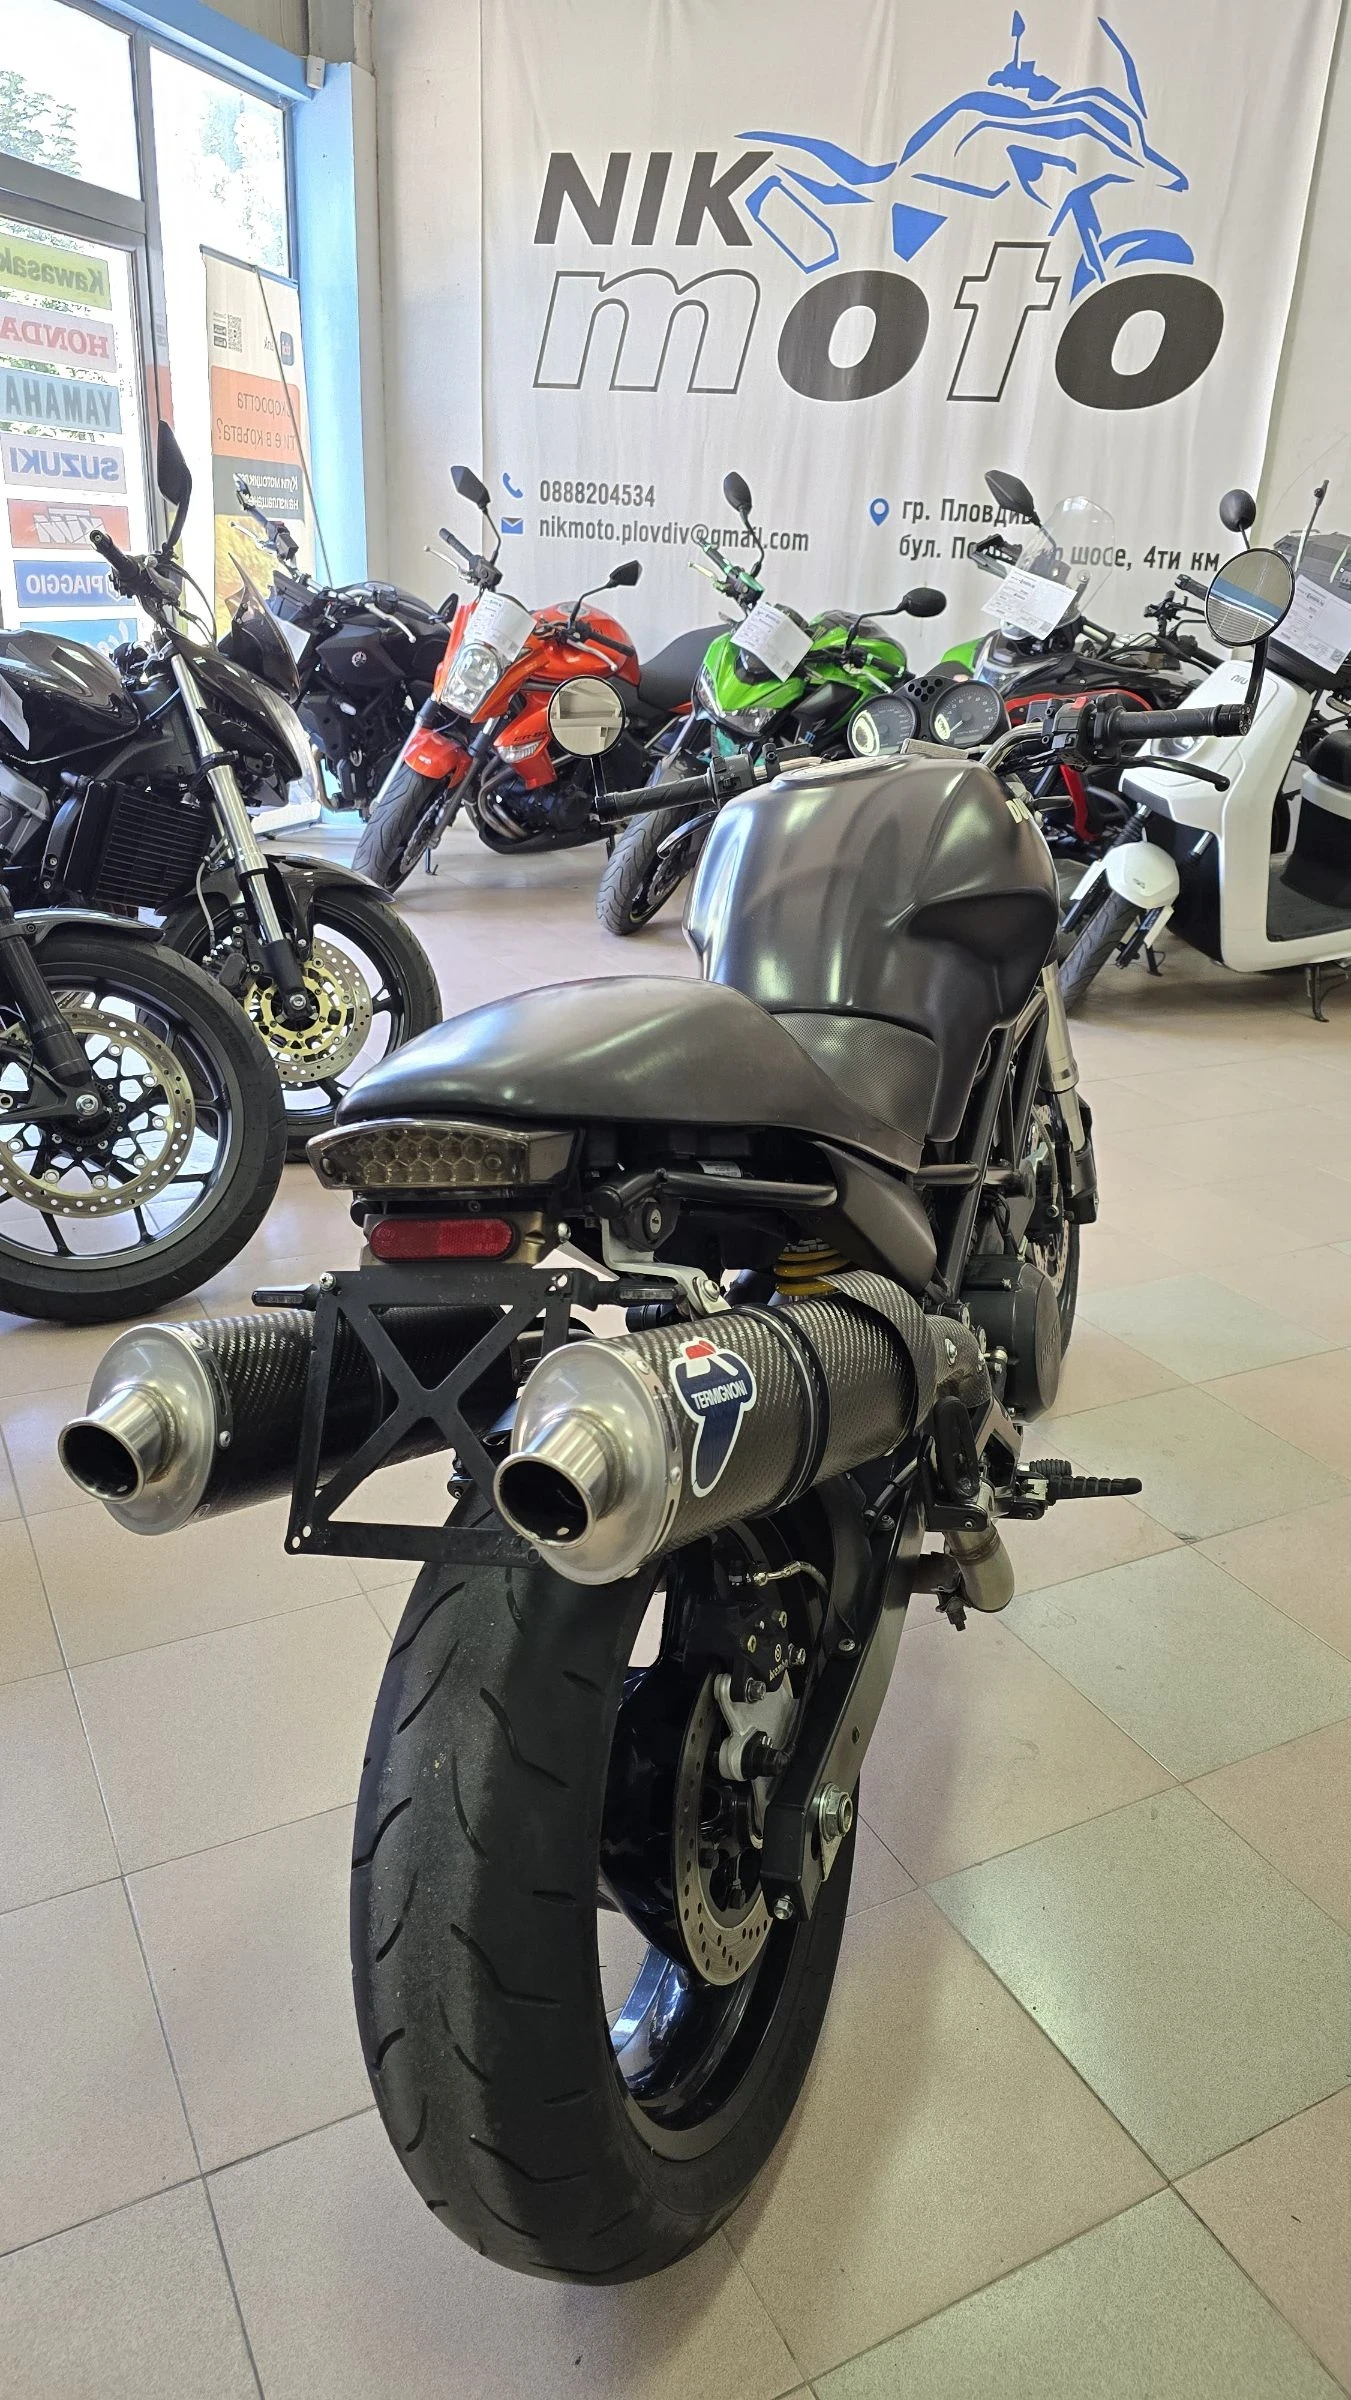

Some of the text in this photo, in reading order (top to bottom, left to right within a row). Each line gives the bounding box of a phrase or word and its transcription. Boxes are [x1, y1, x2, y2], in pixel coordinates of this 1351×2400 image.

[534, 151, 774, 246] NIK
[533, 241, 1224, 410] moto
[540, 480, 656, 508] 0888204534
[902, 500, 930, 524] гр.
[539, 515, 810, 551] nikmoto.plovdiv@gmail.com
[899, 533, 941, 560] бул.
[1070, 546, 1132, 571] шосе,
[1143, 545, 1182, 570] 4ти
[1191, 552, 1220, 572] км
[691, 1379, 748, 1410] TERMIGNONI
